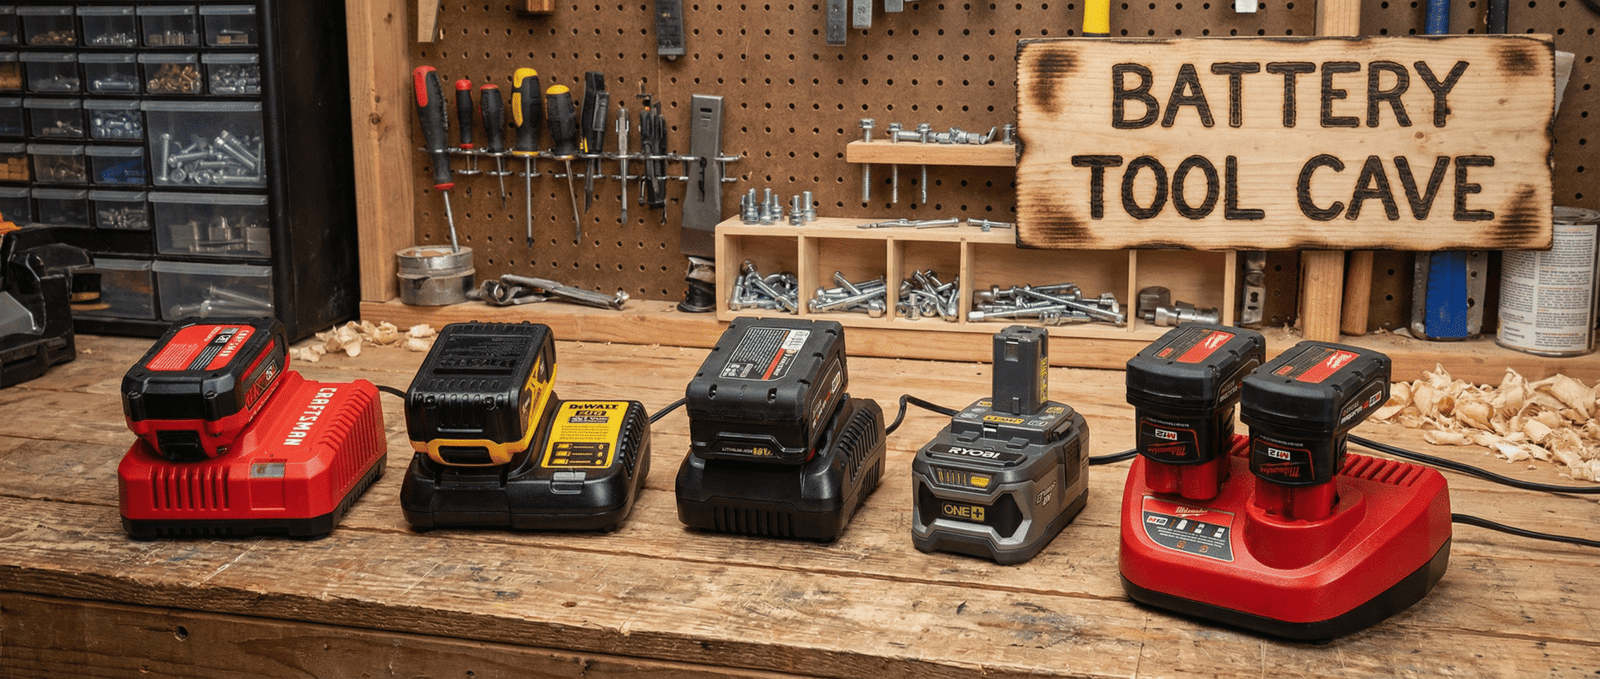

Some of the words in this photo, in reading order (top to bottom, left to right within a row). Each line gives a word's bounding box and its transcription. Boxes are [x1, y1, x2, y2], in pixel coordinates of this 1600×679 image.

[1111, 60, 1470, 130] BATTERY
[1071, 154, 1266, 221] TOOL
[1296, 153, 1496, 222] CAVE
[283, 387, 338, 446] CRAFTSMAN
[1155, 429, 1177, 440] M12
[948, 446, 1001, 459] RYOBI
[1268, 448, 1290, 460] M12
